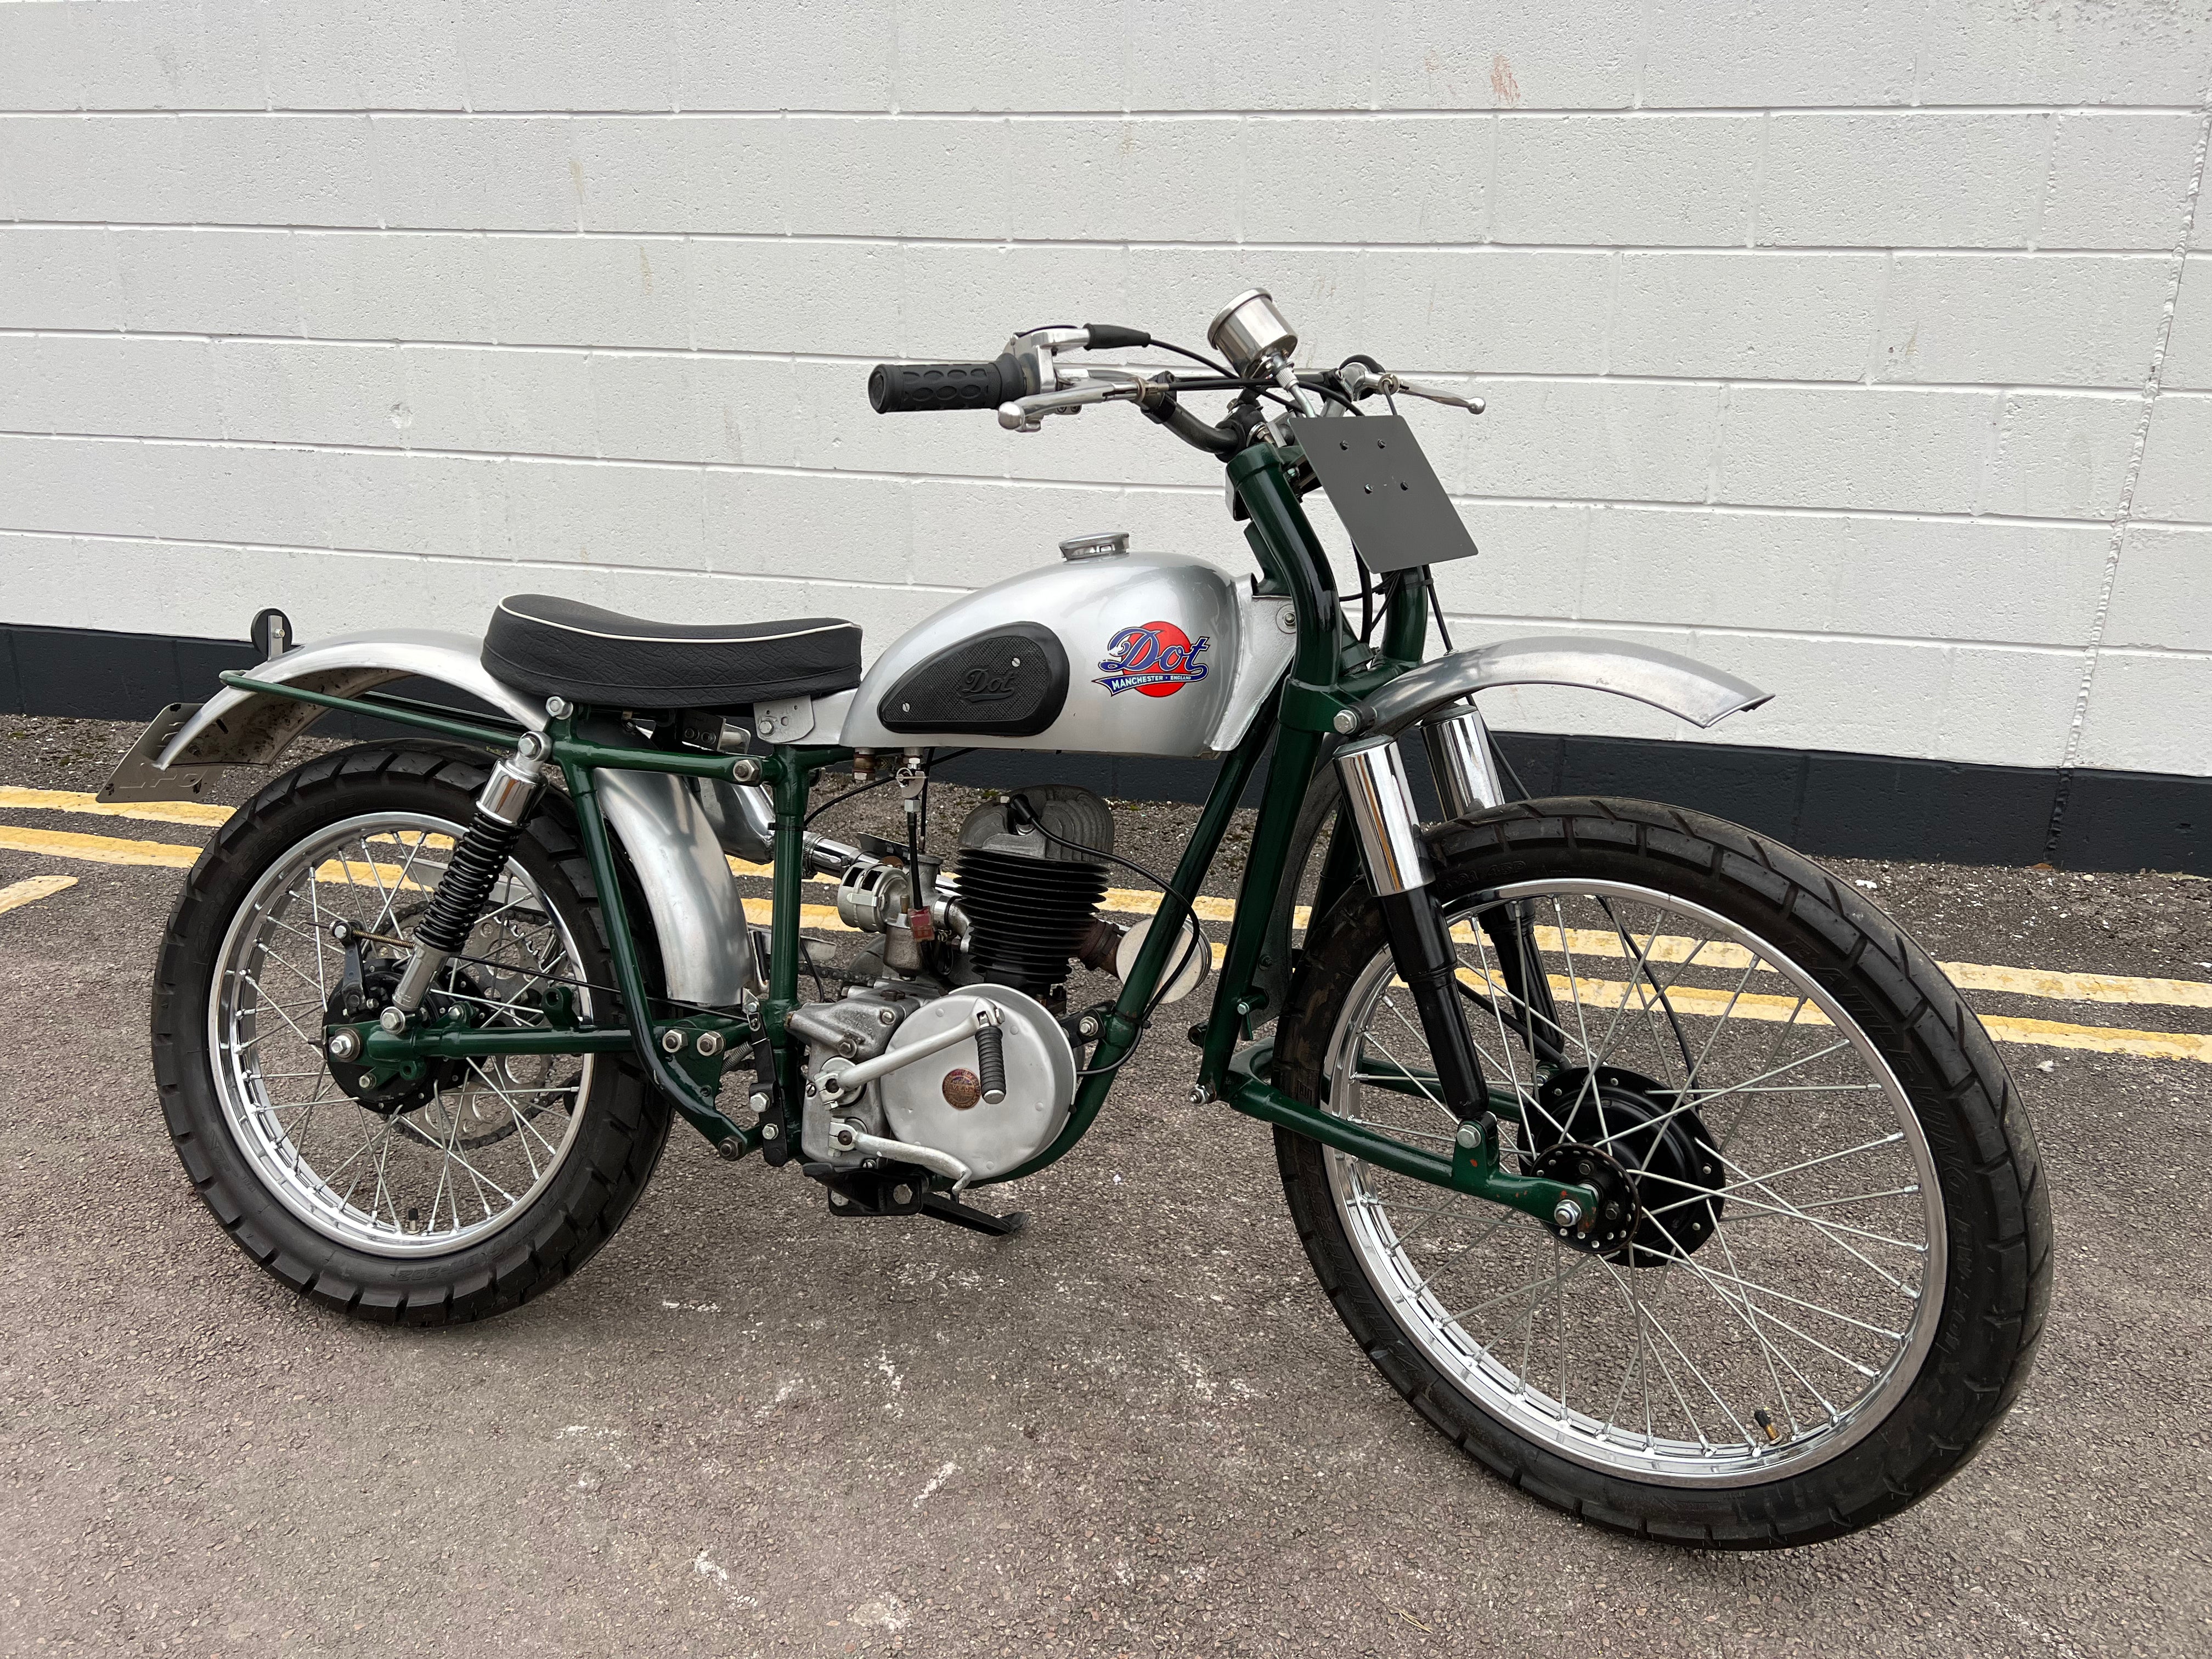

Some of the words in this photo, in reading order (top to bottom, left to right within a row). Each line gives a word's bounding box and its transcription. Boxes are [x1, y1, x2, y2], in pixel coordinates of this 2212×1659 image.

[1098, 627, 1210, 675] Dot
[961, 668, 1015, 694] Dot
[1111, 675, 1163, 690] MANCHESTER
[1487, 860, 1527, 877] 45P
[1782, 930, 1924, 1079] BATTLE
[1908, 1078, 1973, 1195] WING
